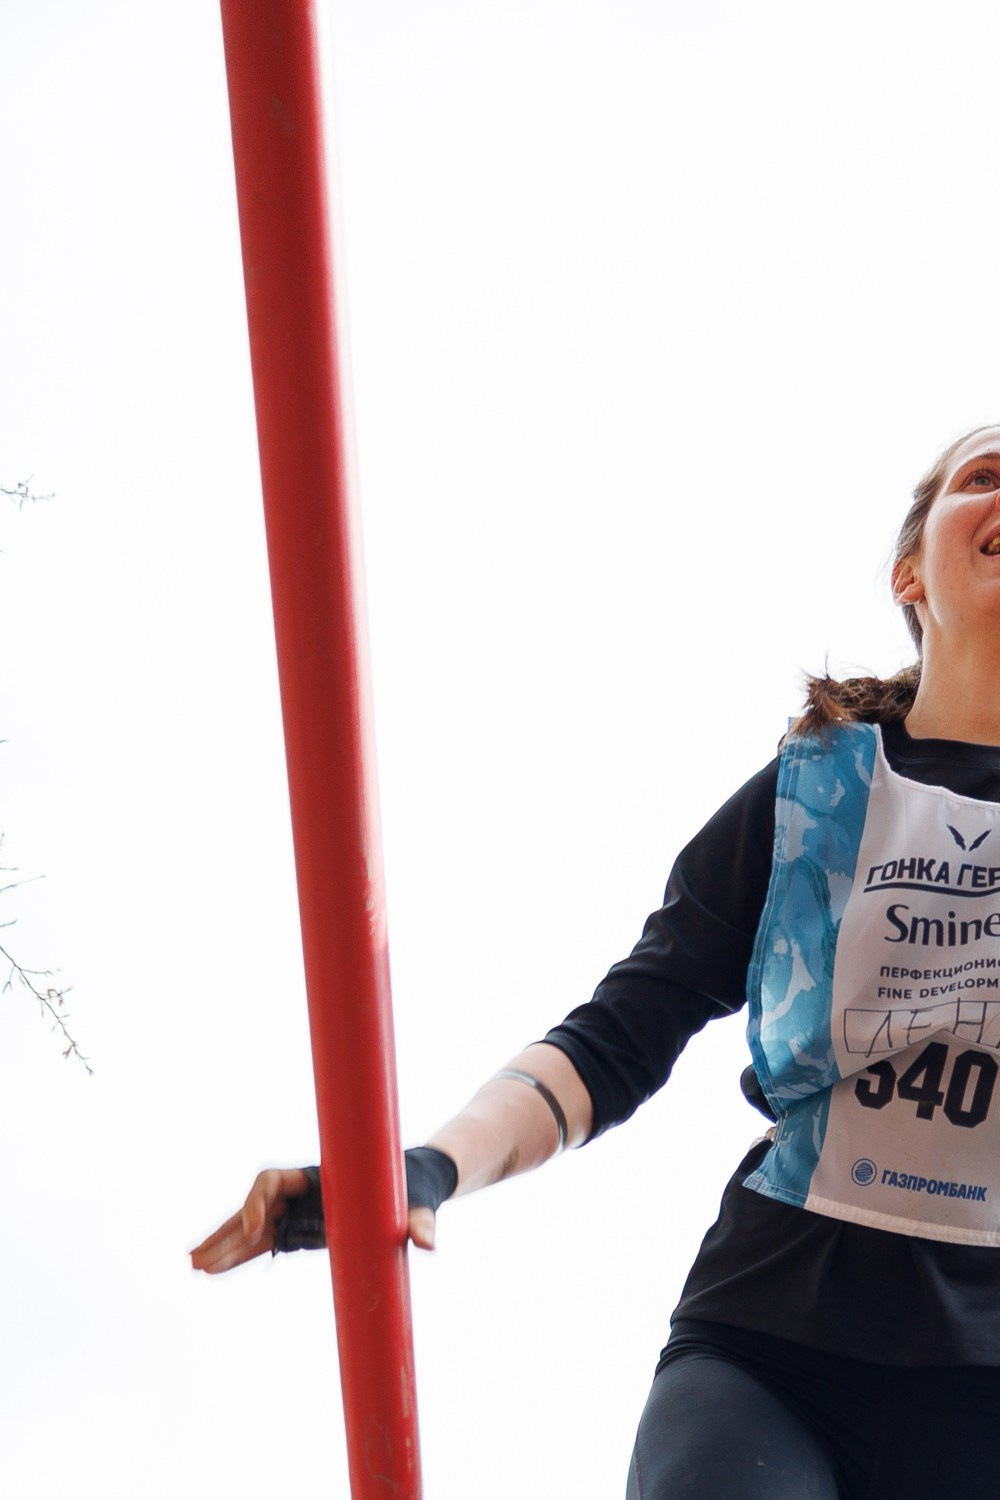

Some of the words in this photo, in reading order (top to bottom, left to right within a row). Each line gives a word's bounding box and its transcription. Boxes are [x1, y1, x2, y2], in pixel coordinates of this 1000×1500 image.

[866, 857, 949, 884] ГОНКА
[878, 987, 912, 999] FINE
[881, 1169, 987, 1202] ГАЗПРОМБАНК
